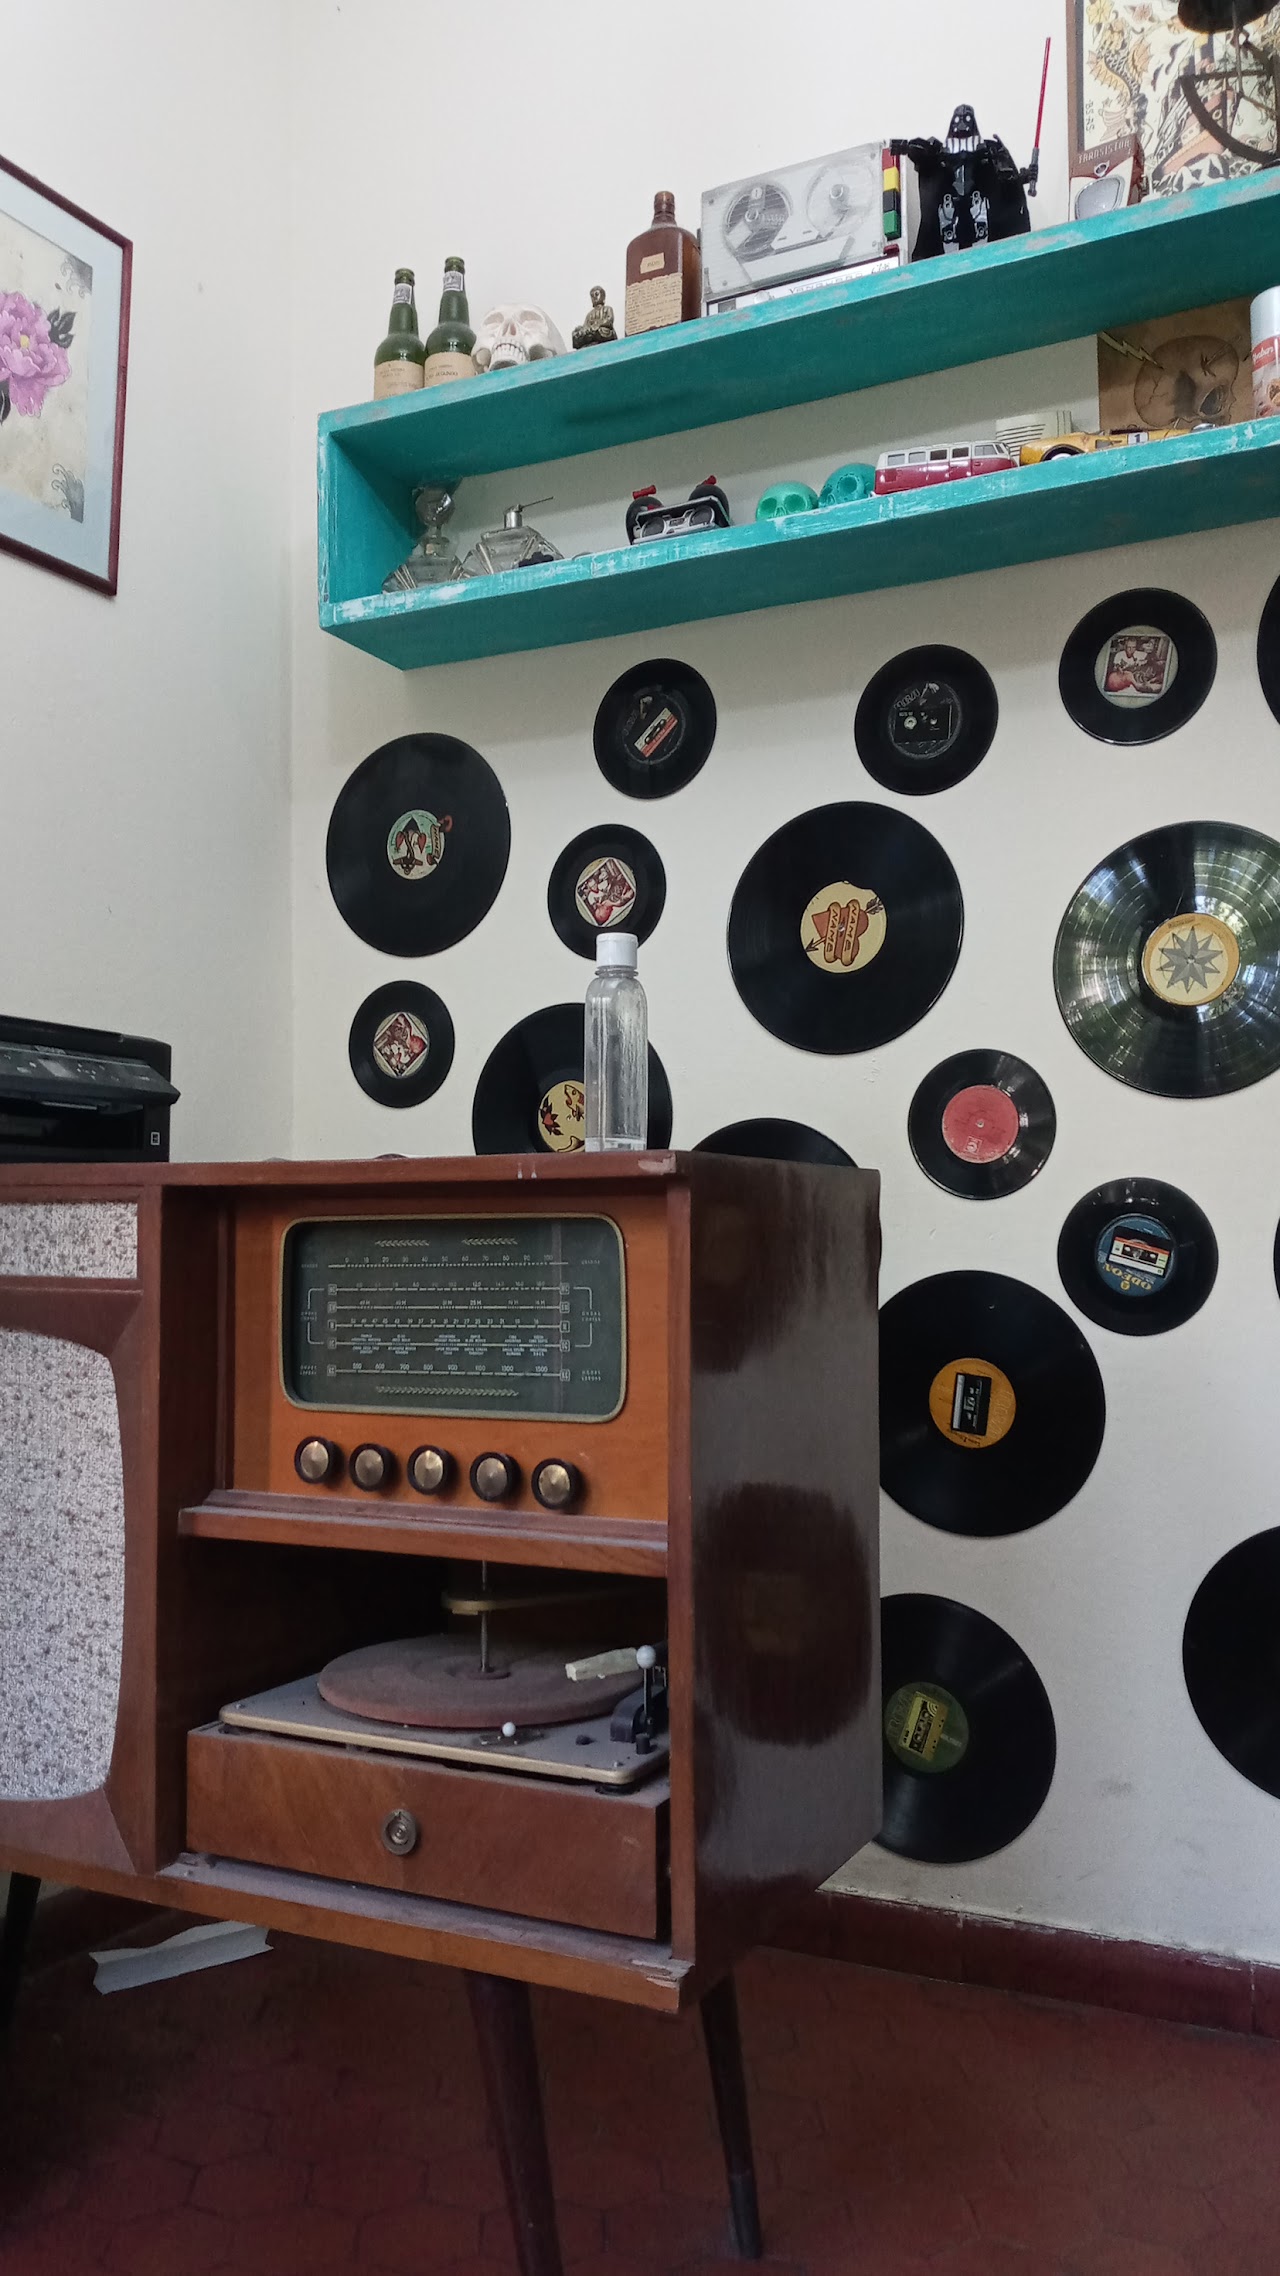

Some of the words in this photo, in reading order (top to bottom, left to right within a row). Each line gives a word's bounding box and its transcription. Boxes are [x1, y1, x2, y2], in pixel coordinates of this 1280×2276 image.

[1134, 434, 1141, 444] 1
[826, 909, 838, 953] NAME
[844, 904, 859, 952] NAME
[1104, 1263, 1152, 1290] ODEON
